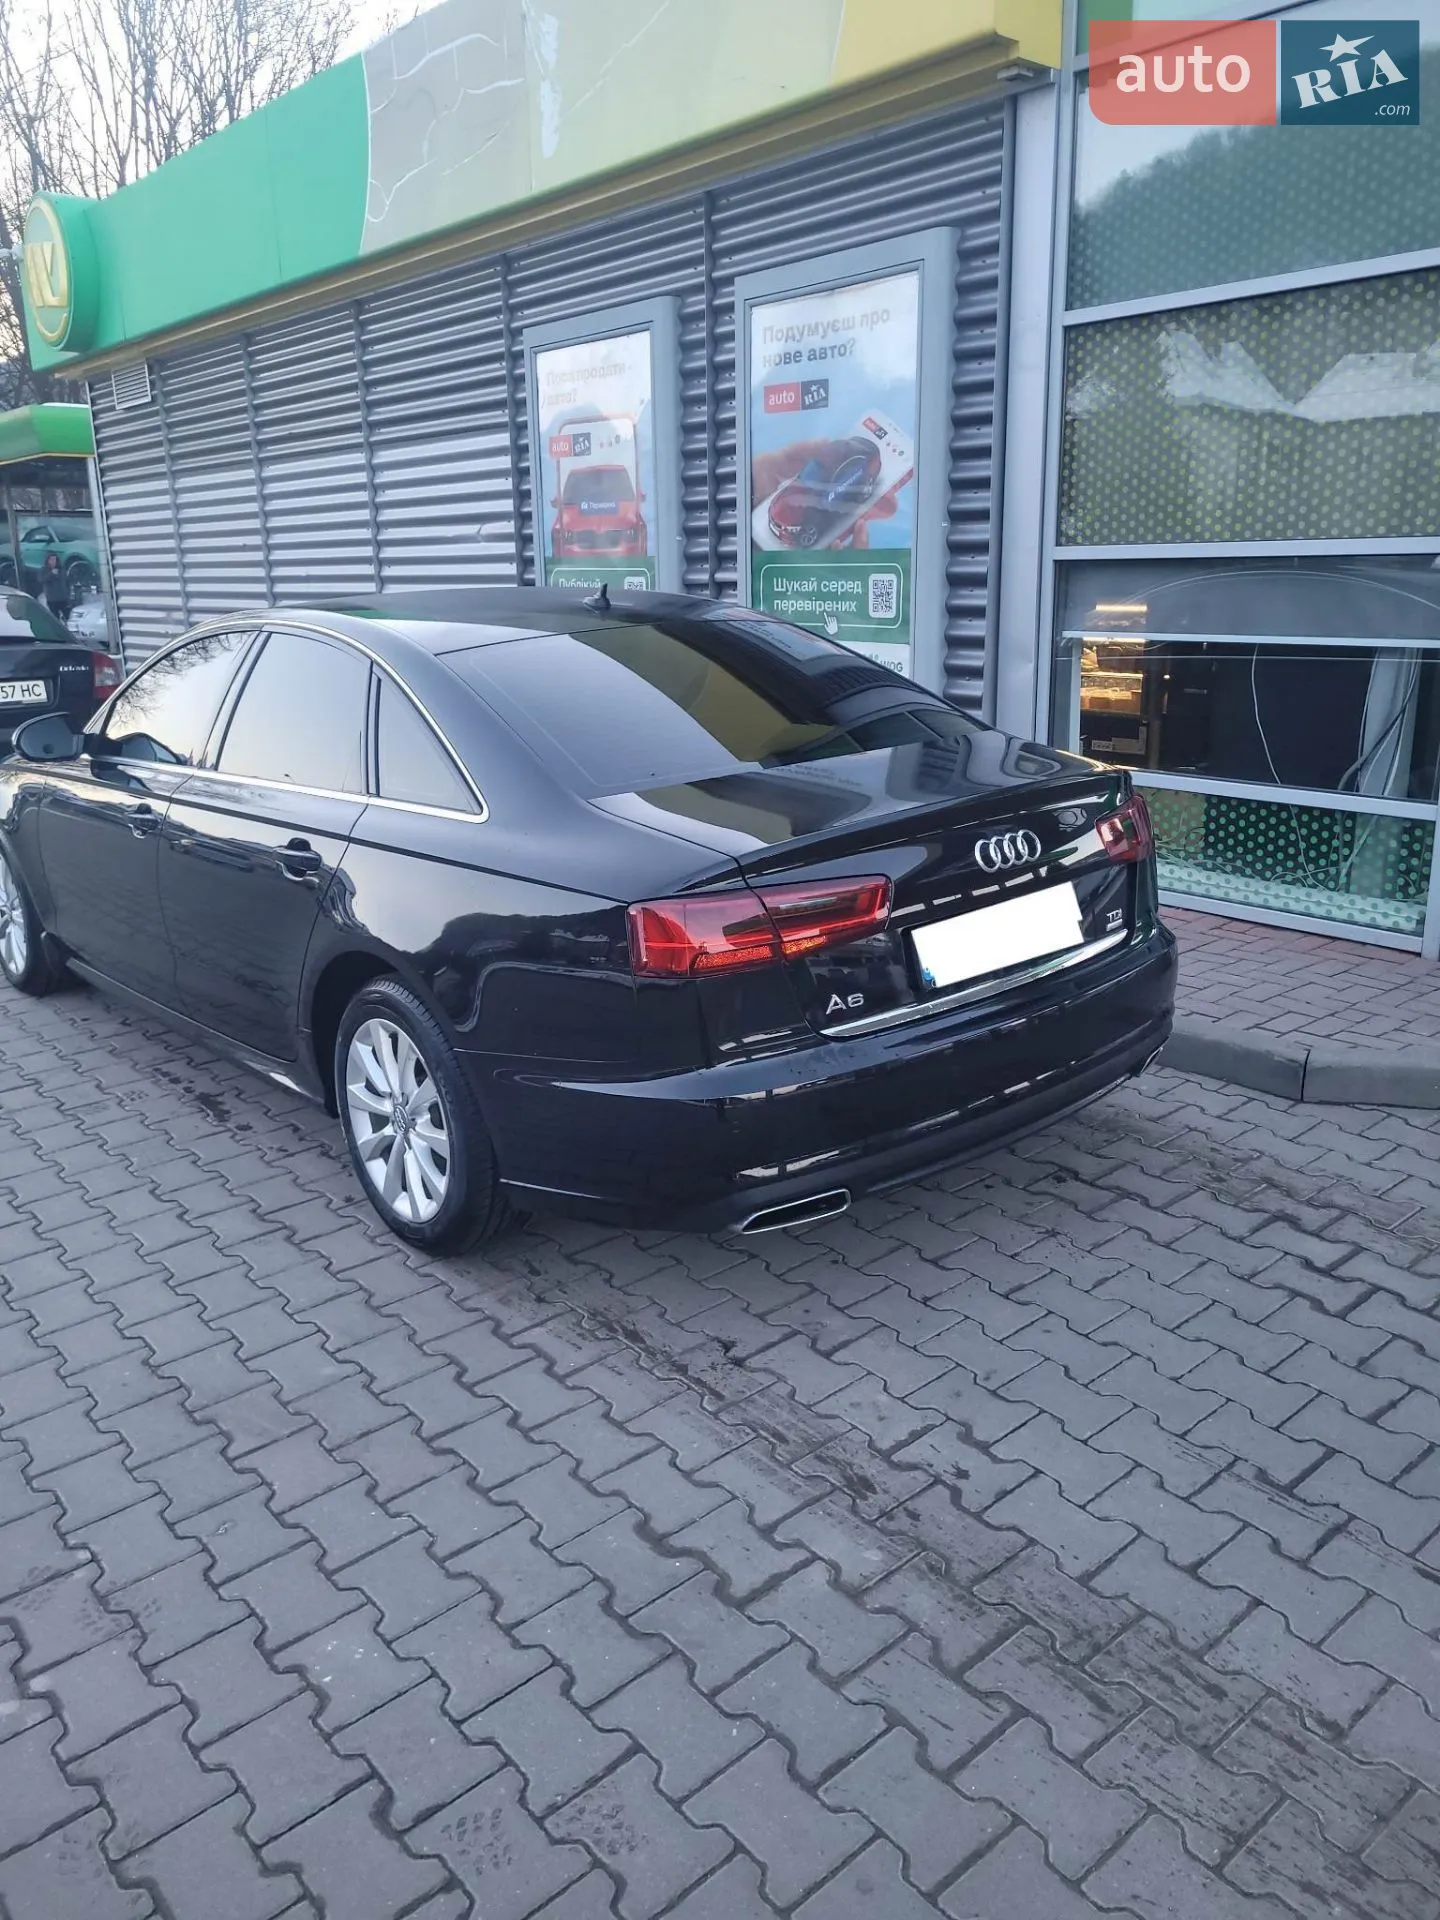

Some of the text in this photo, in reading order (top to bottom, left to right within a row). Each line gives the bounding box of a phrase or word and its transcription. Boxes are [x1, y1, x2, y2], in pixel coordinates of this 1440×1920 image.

[762, 308, 891, 345] Подумуєш про
[763, 337, 856, 368] нове авто?
[769, 390, 795, 406] auto
[804, 387, 826, 405] RIA
[773, 577, 863, 595] Шукай серед
[773, 597, 857, 615] перевірених
[20, 683, 42, 698] HC
[825, 992, 865, 1016] A6
